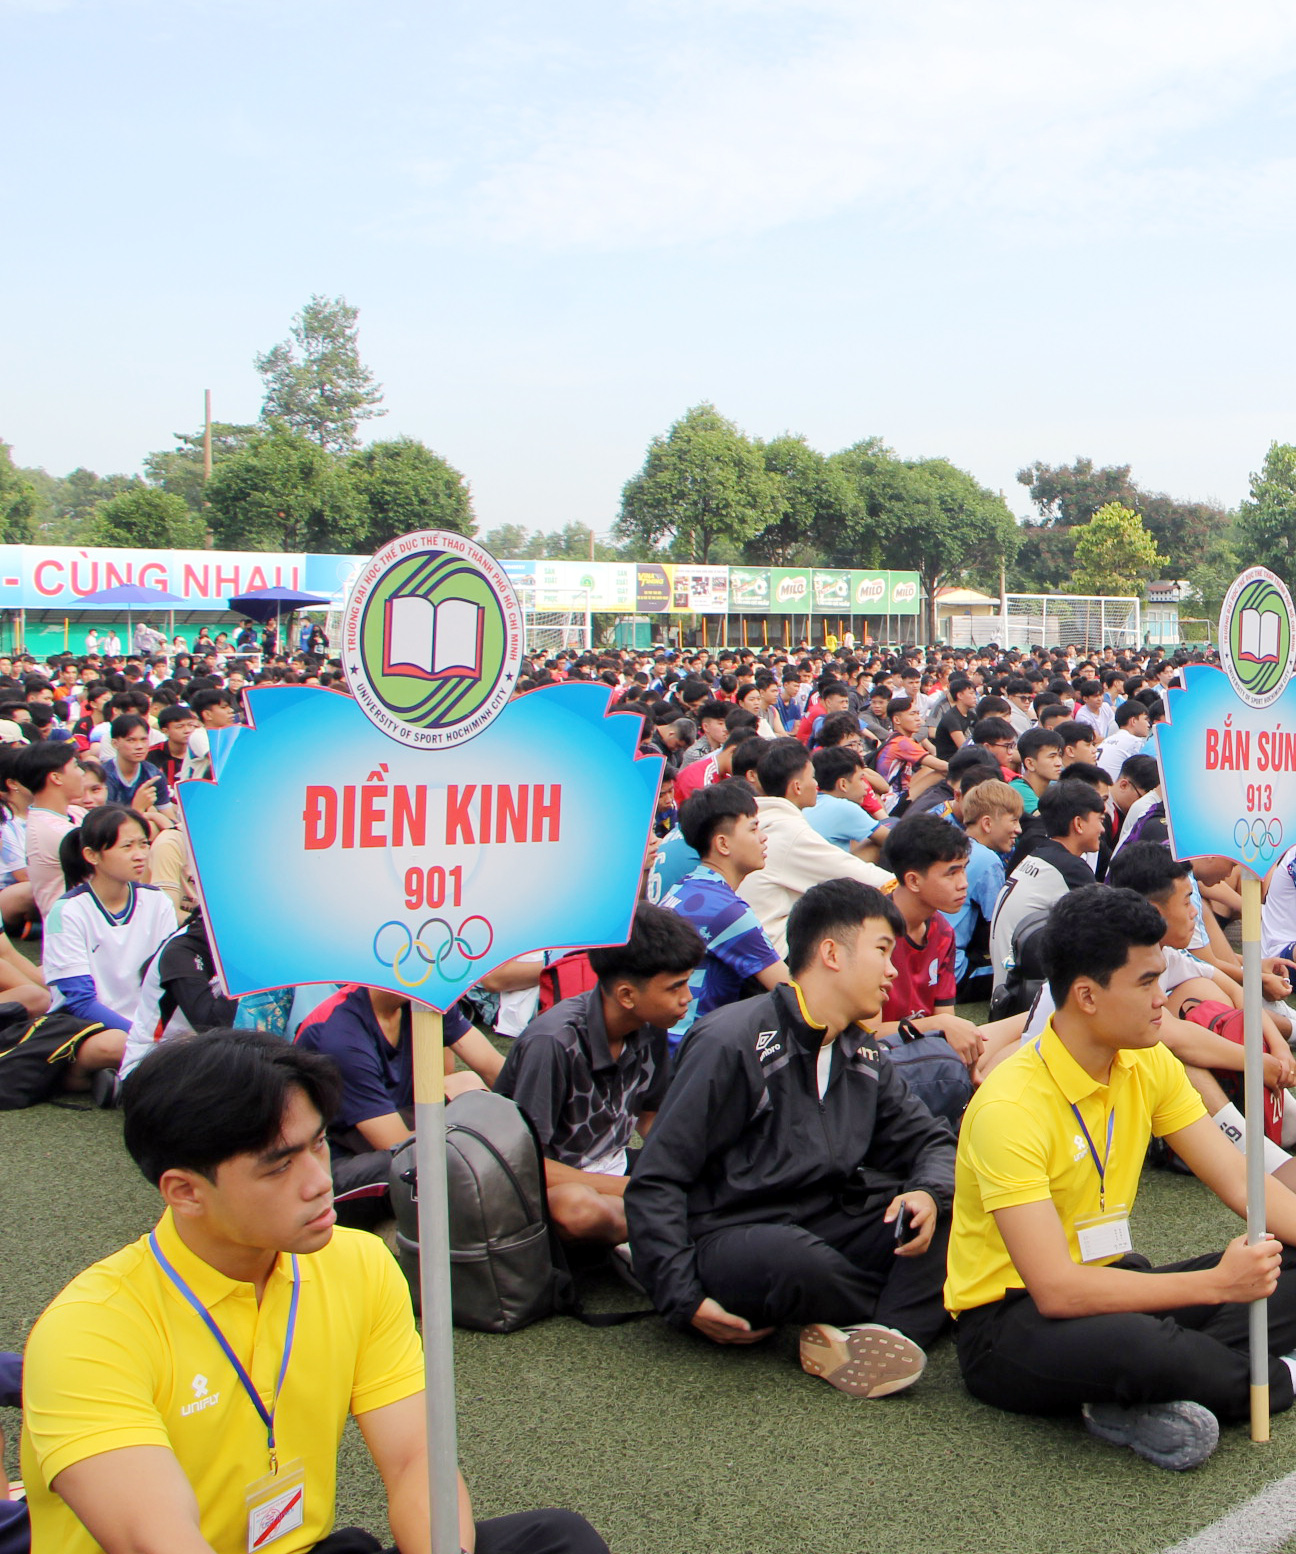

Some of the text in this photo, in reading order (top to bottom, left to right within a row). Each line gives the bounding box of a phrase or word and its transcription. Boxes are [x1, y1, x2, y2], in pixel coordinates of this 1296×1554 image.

[33, 551, 168, 596] CÙNG
[183, 563, 299, 598] NHAU
[780, 585, 805, 595] MILO
[860, 586, 883, 597] MILO
[895, 587, 914, 597] MILO
[399, 539, 419, 553] DỤC
[442, 537, 466, 552] THAO
[509, 633, 519, 661] MINH
[356, 683, 507, 744] UNIVERSITY OF SPORT HOCHIMINH CITY
[1205, 713, 1250, 772] BẮN
[302, 762, 562, 851] ĐIỀN KINH
[1246, 783, 1272, 812] 913
[404, 865, 463, 910] 901
[181, 1392, 220, 1417] UNIFLY
